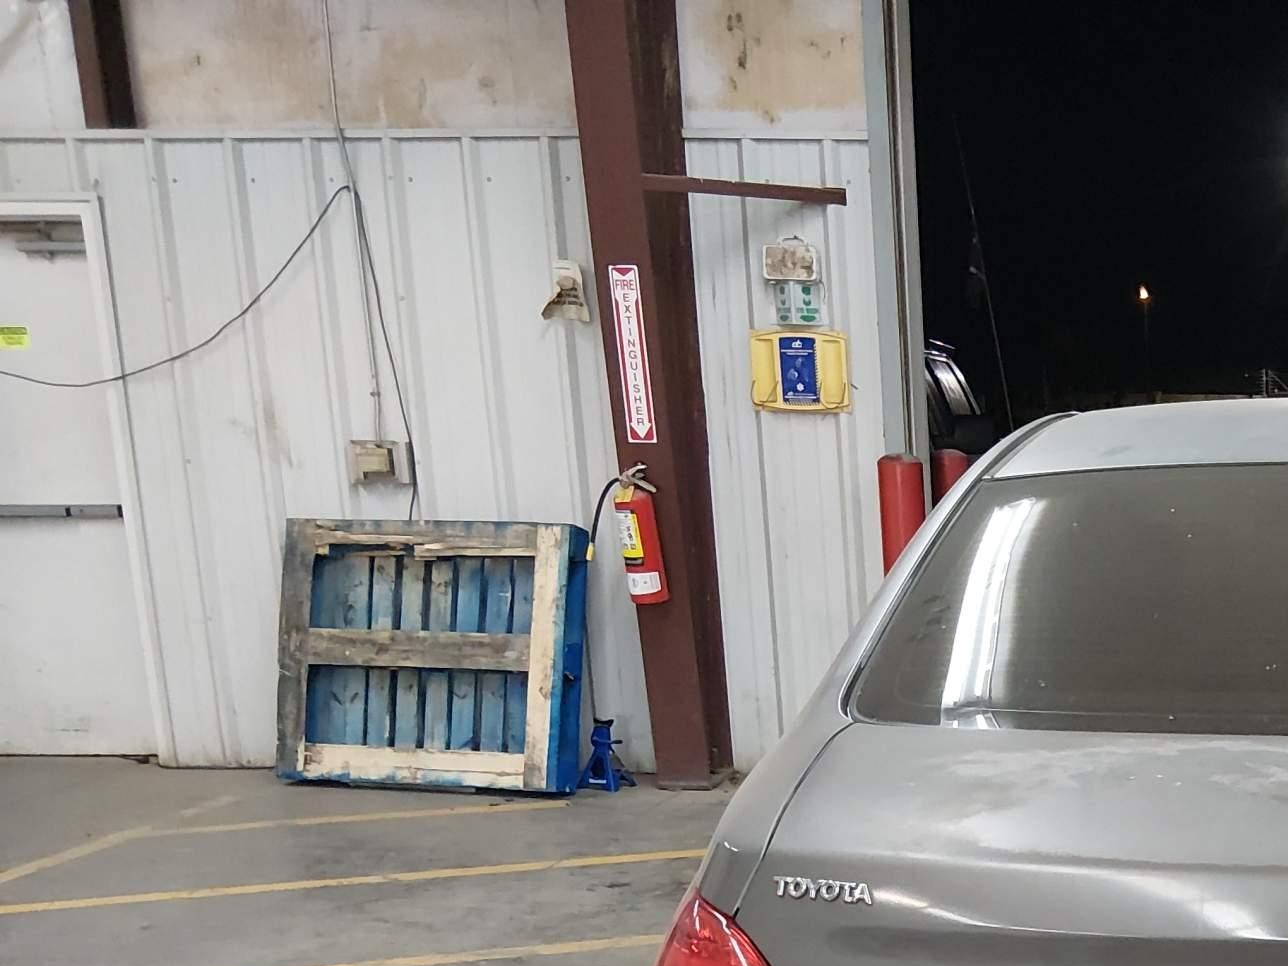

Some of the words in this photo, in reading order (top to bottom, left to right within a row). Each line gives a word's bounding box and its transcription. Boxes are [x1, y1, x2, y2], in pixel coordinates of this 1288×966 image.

[615, 279, 636, 291] FIRE
[622, 293, 646, 425] EXTINGUISHER
[773, 876, 872, 905] TOYOTA
